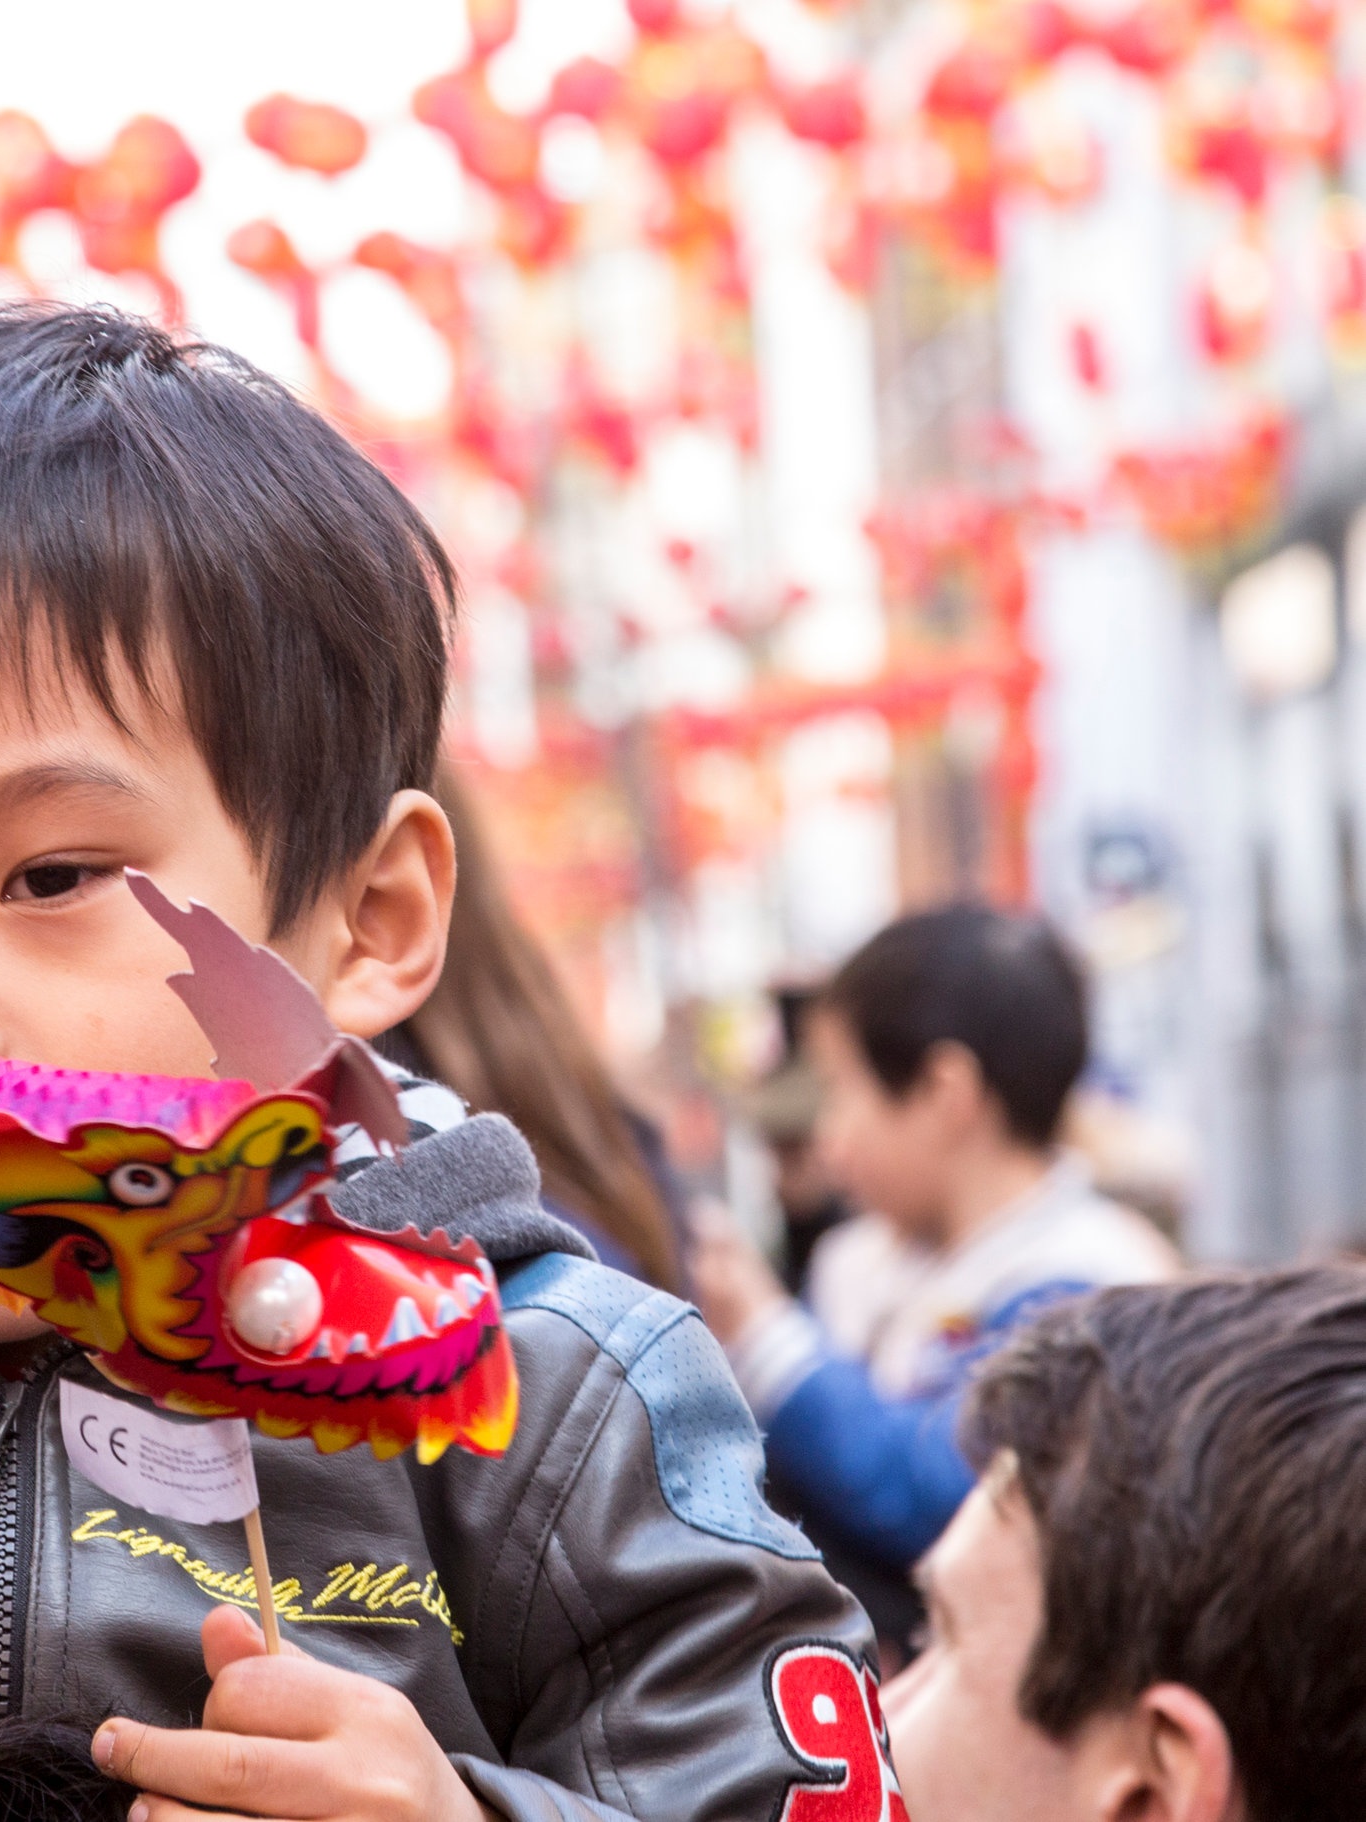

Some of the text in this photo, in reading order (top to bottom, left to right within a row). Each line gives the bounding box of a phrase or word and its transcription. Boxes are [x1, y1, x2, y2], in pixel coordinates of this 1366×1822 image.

[79, 1414, 128, 1467] CE
[71, 1509, 303, 1622] Lightnig
[770, 1644, 910, 1822] 9
